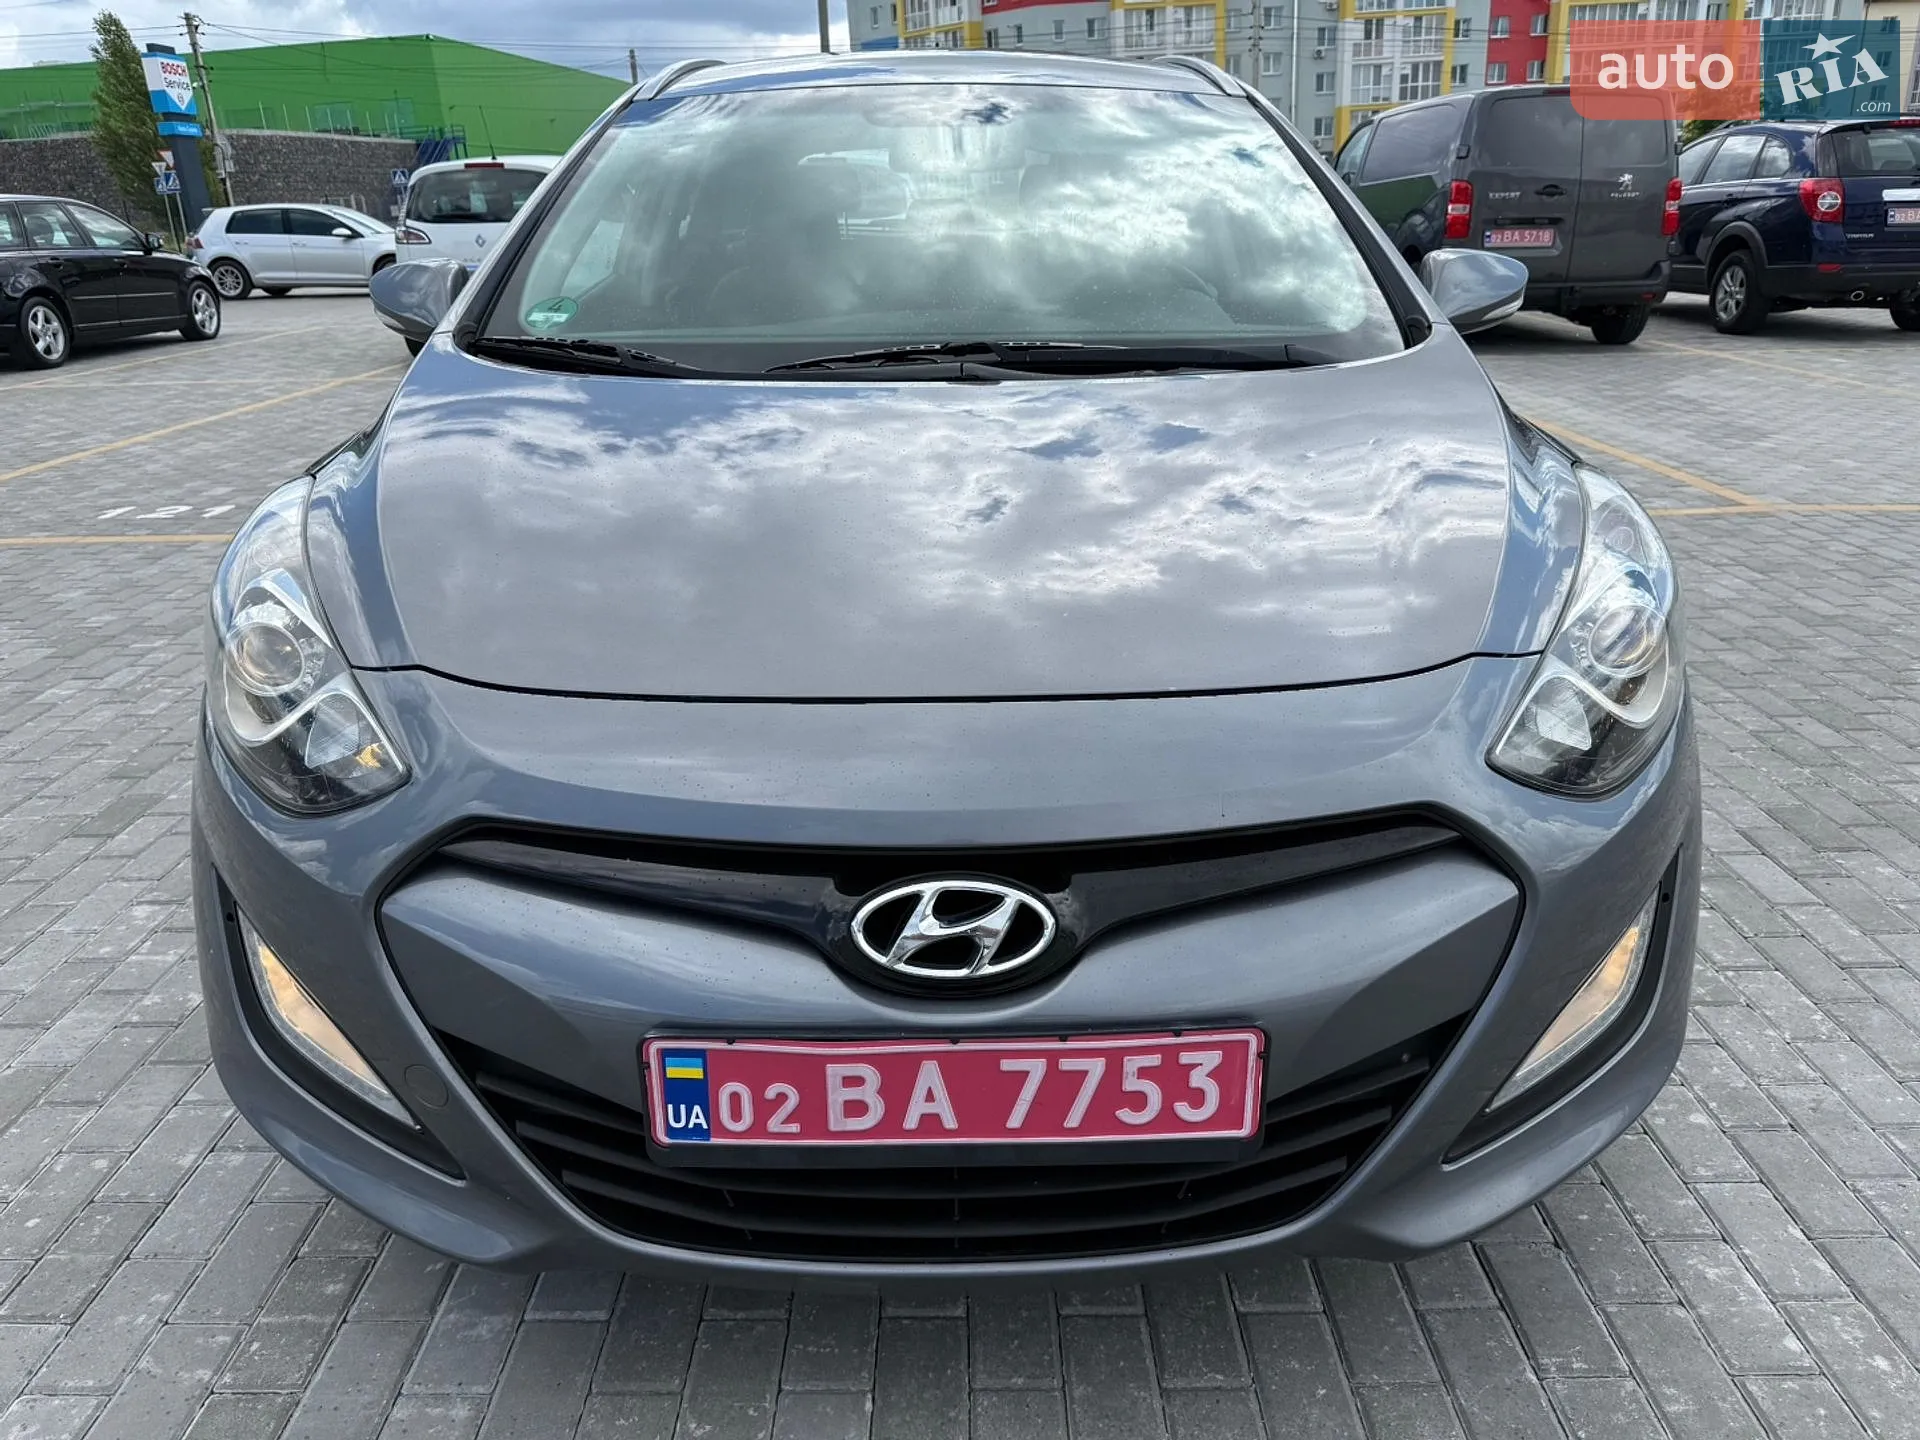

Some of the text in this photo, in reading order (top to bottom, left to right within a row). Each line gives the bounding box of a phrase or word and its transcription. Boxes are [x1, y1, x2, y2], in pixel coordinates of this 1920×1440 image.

[160, 61, 188, 76] BOSCH
[164, 77, 191, 91] Service
[1503, 231, 1520, 242] BA
[1524, 230, 1551, 242] 5718
[97, 504, 236, 519] 121
[718, 1051, 1223, 1133] 02 BA 7753
[667, 1103, 709, 1129] UA
